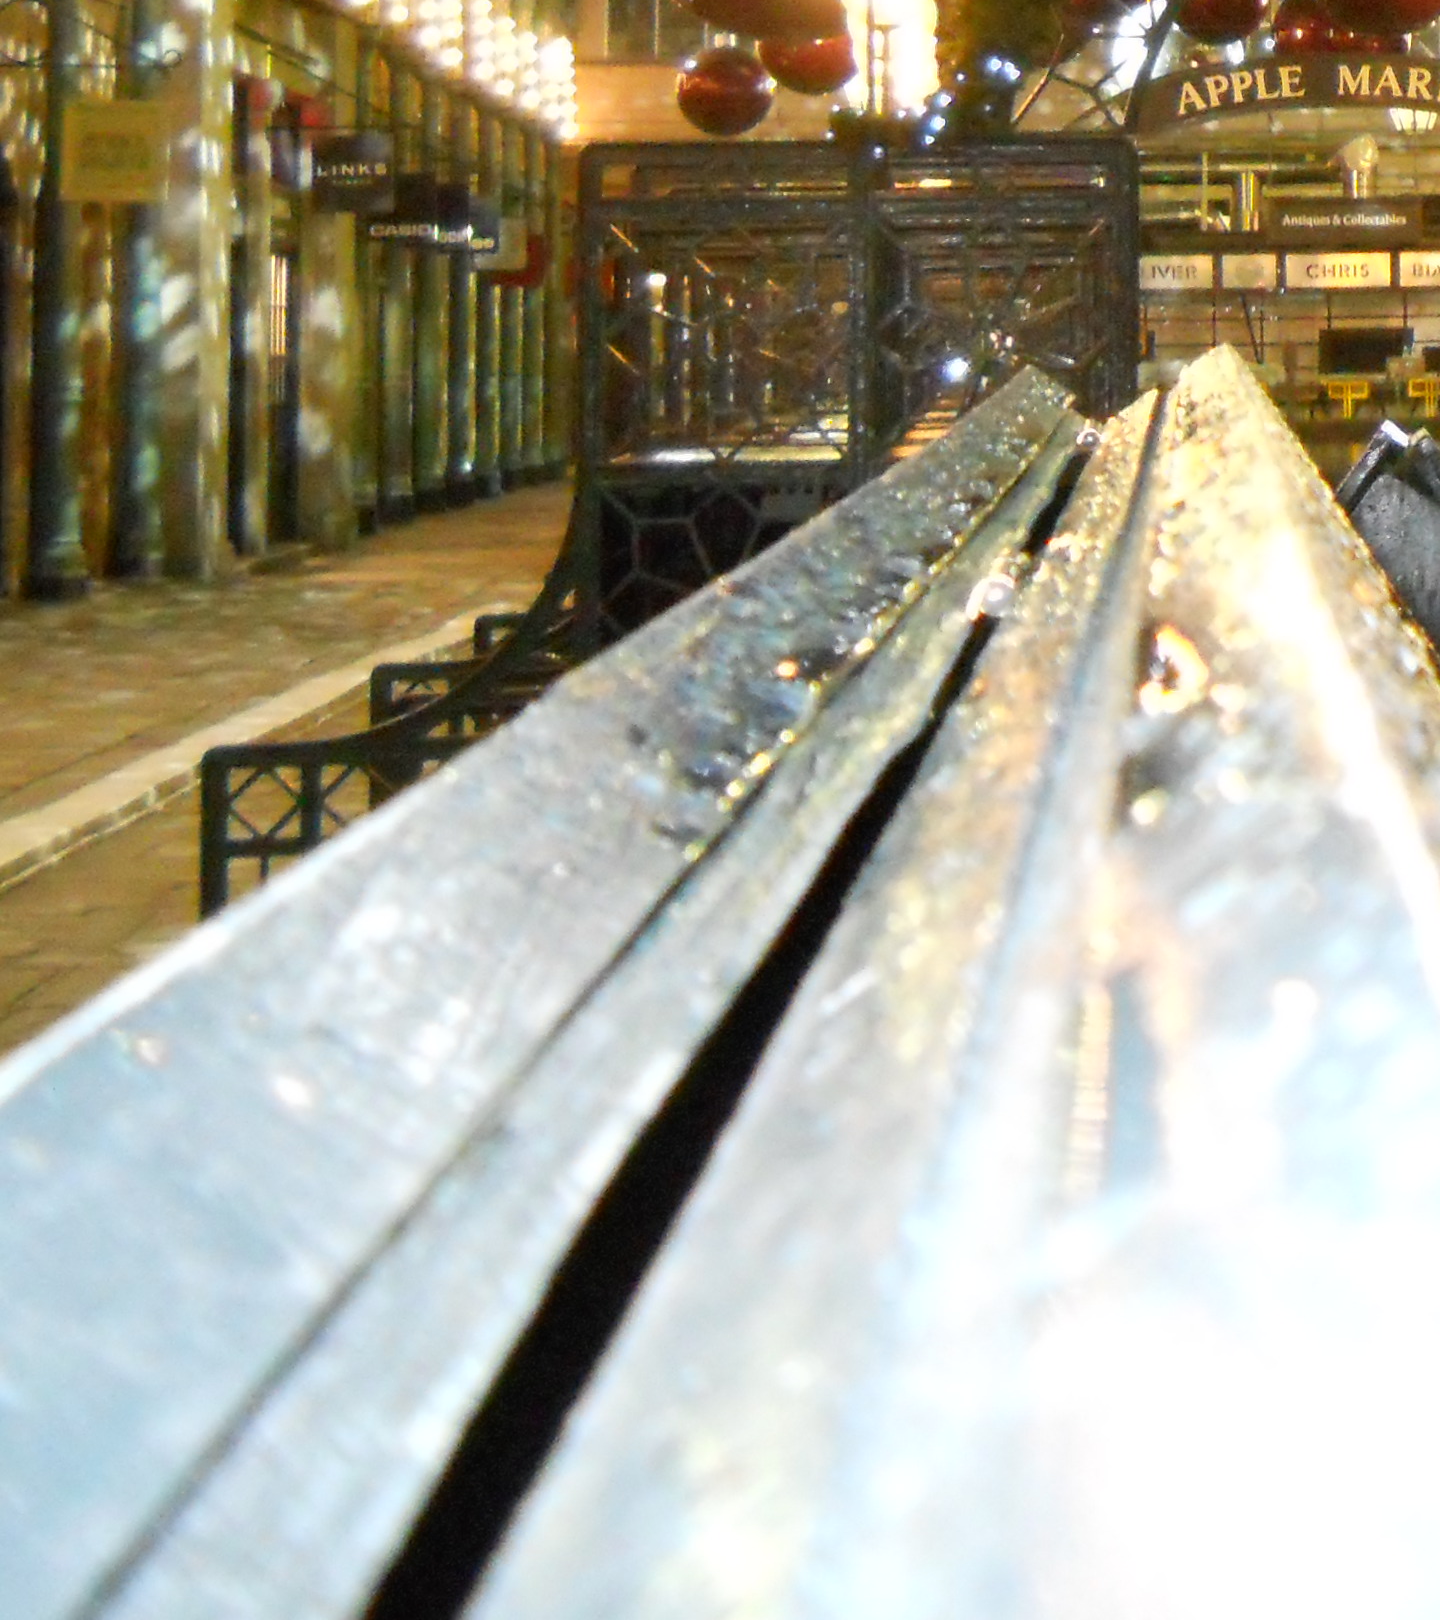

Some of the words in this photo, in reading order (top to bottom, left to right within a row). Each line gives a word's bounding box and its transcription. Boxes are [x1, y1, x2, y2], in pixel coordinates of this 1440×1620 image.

[1176, 65, 1306, 115] APPLE
[1282, 213, 1331, 228] Antiques
[1332, 214, 1342, 226] &
[1342, 213, 1408, 227] Collectables
[1305, 264, 1371, 279] CHRIS
